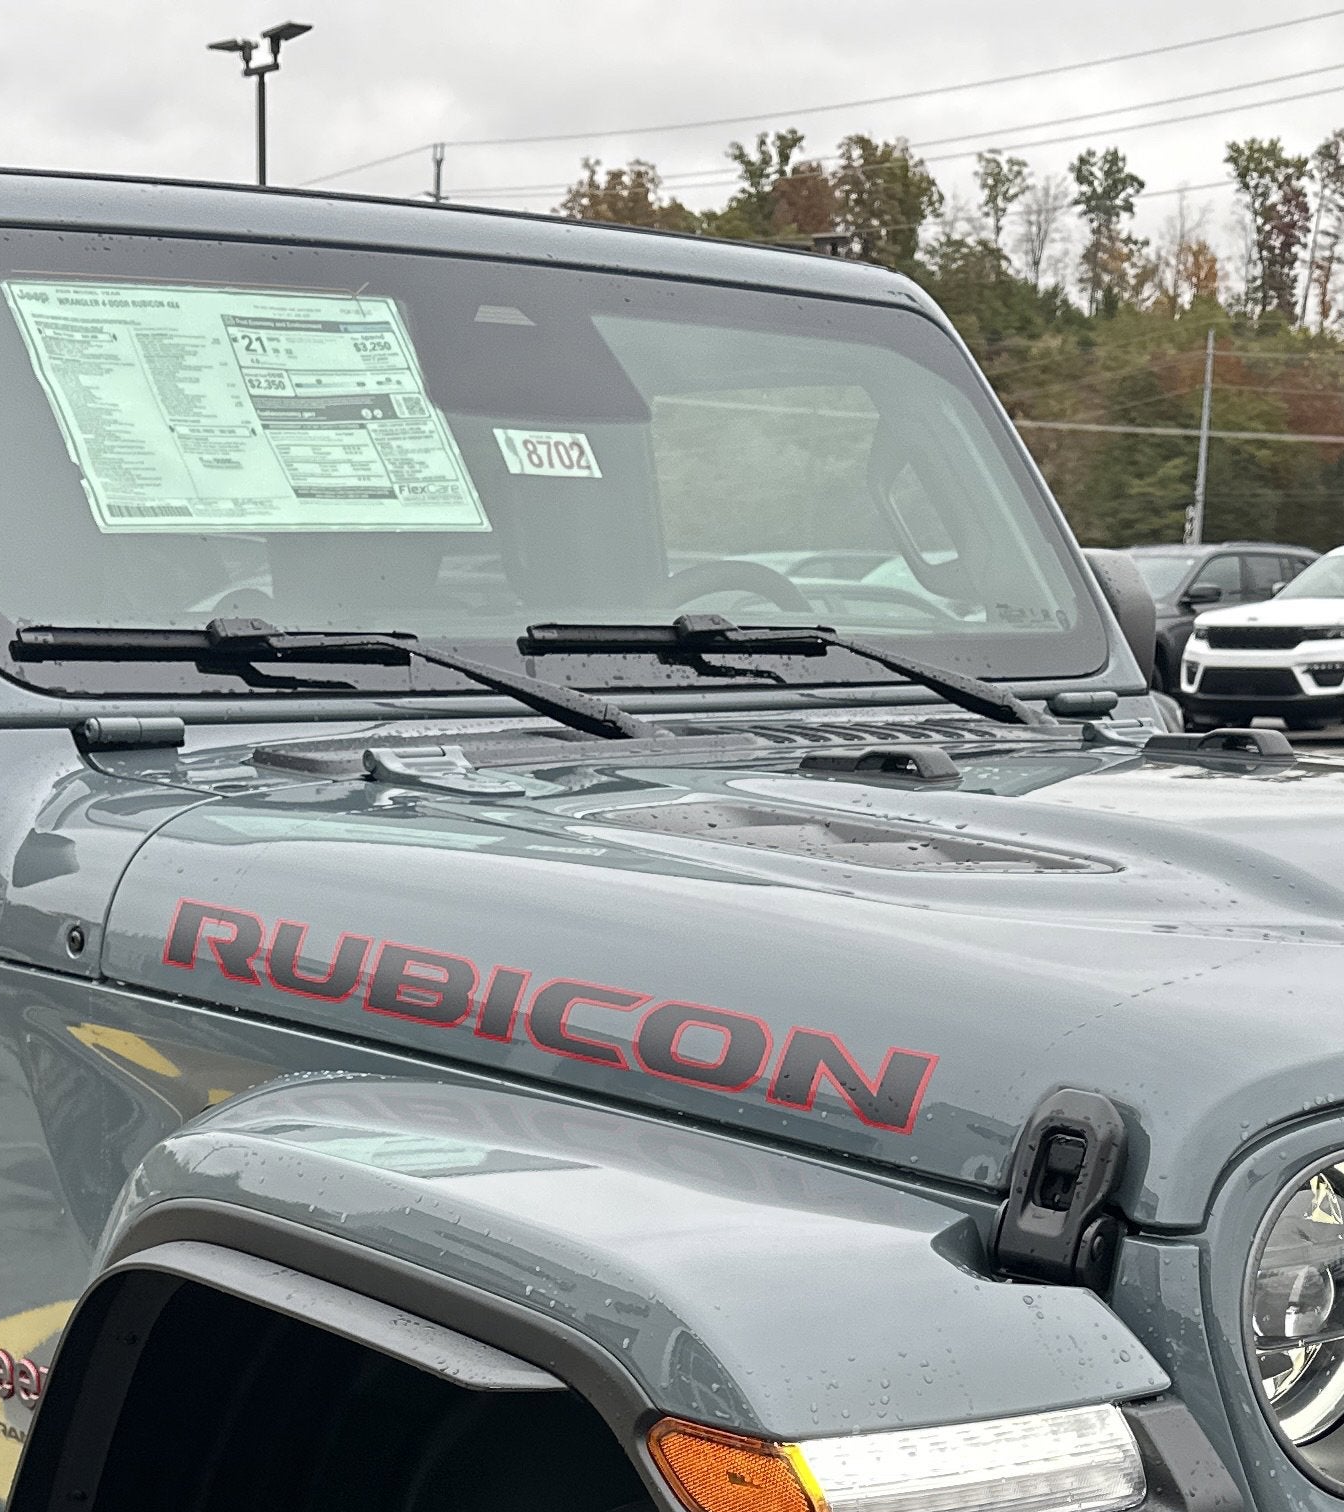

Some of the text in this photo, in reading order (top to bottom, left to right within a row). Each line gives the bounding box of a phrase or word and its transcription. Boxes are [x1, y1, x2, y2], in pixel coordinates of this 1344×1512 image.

[241, 334, 267, 353] 21
[353, 341, 391, 352] $3,250
[248, 378, 286, 391] $2,350
[522, 438, 591, 470] 8702
[399, 483, 460, 495] FlexCare
[162, 898, 940, 1134] RUBICON
